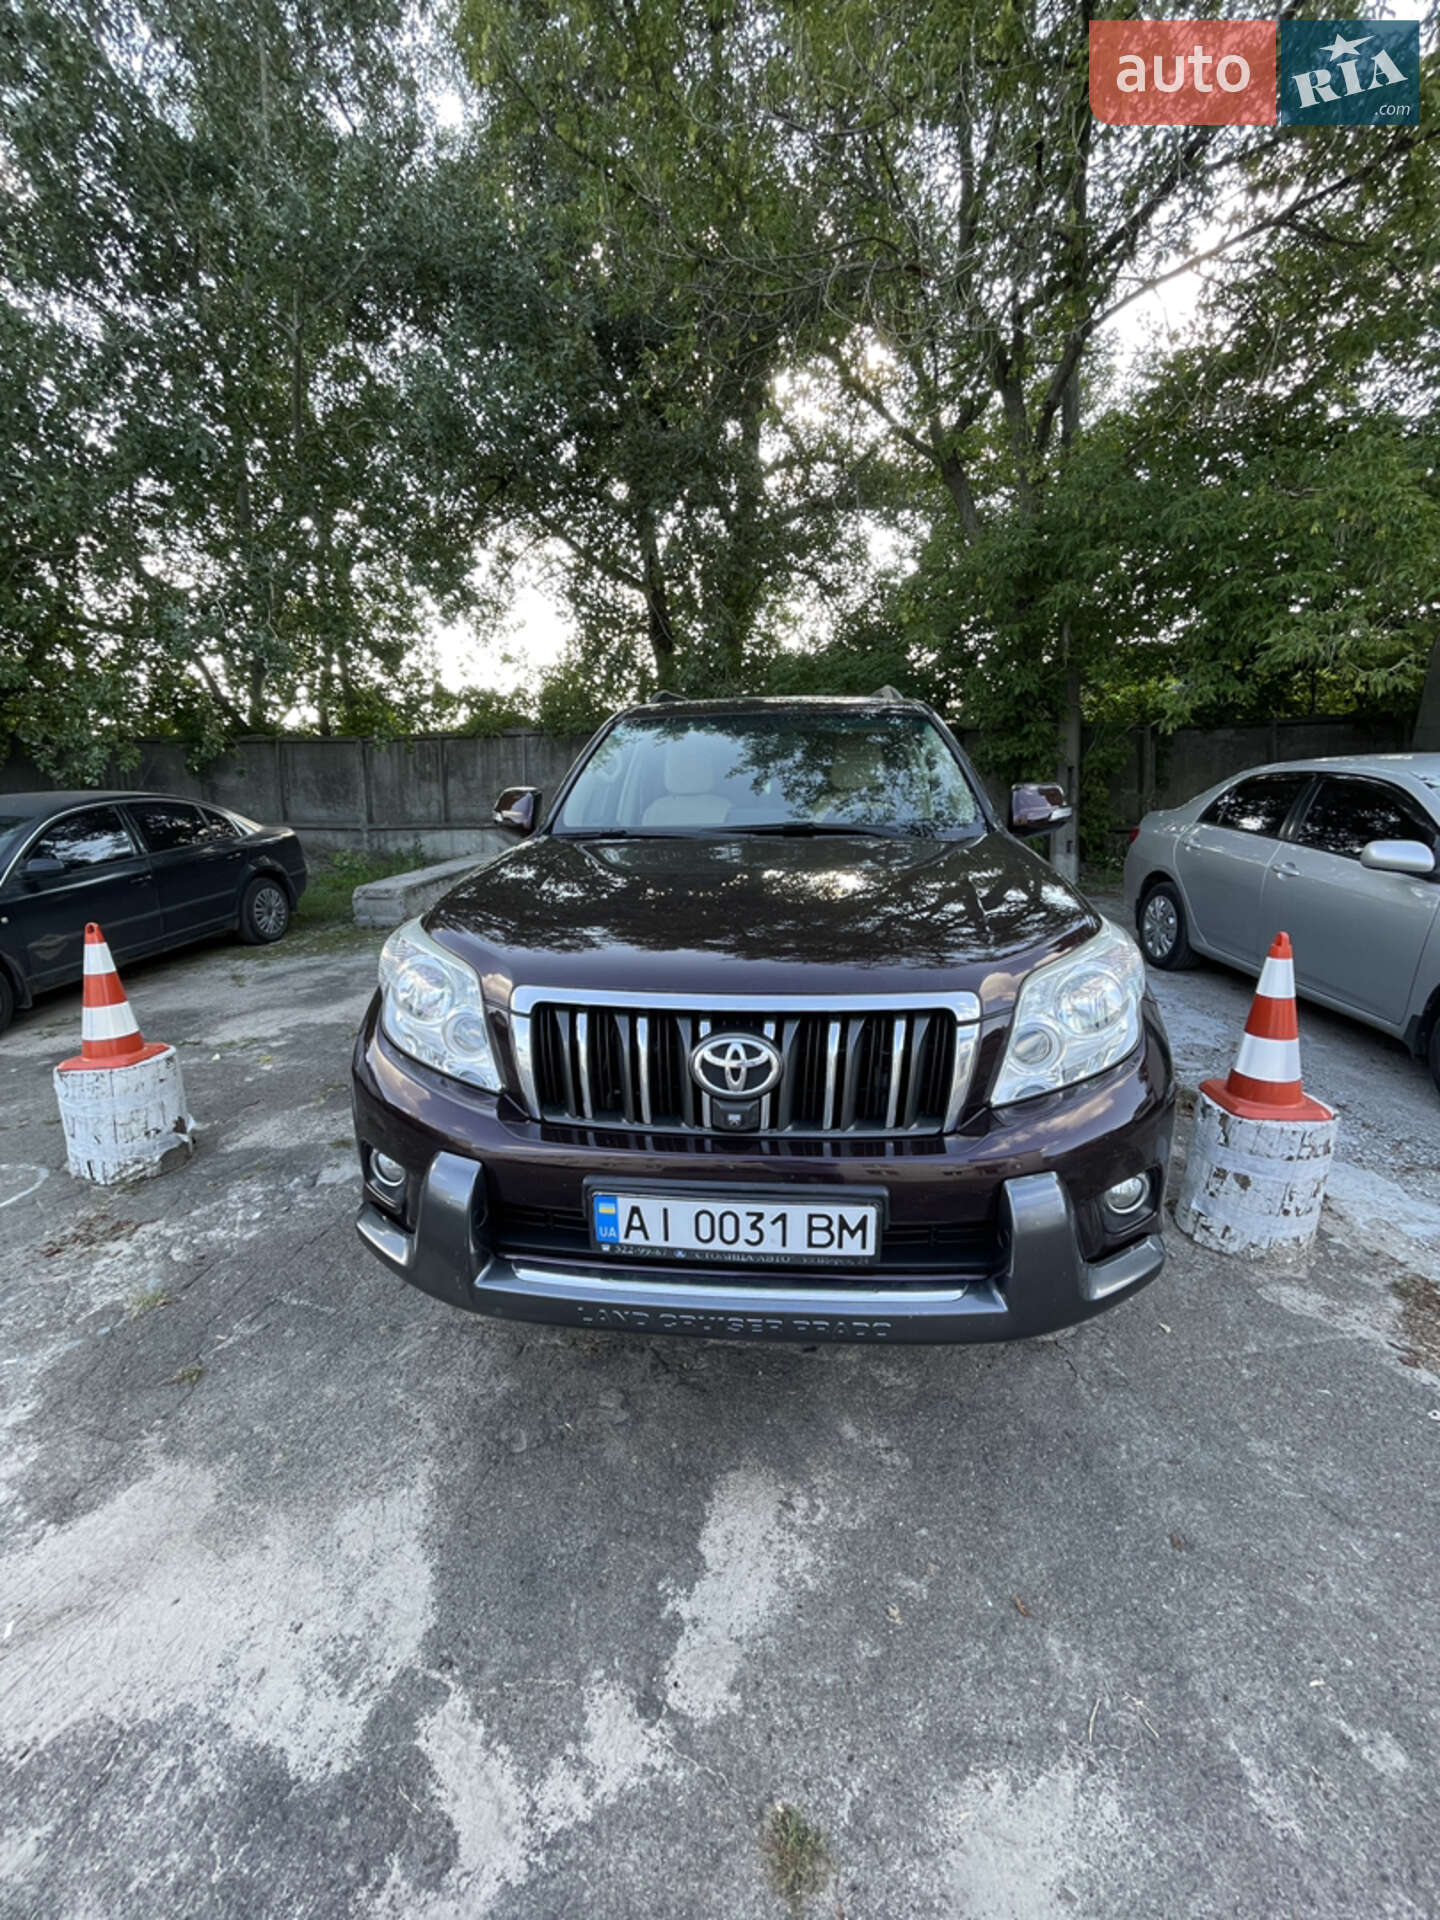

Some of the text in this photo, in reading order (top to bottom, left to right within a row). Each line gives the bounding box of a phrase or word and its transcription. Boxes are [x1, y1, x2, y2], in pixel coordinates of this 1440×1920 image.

[599, 1226, 617, 1238] UA
[623, 1205, 868, 1250] AI 0031 BM
